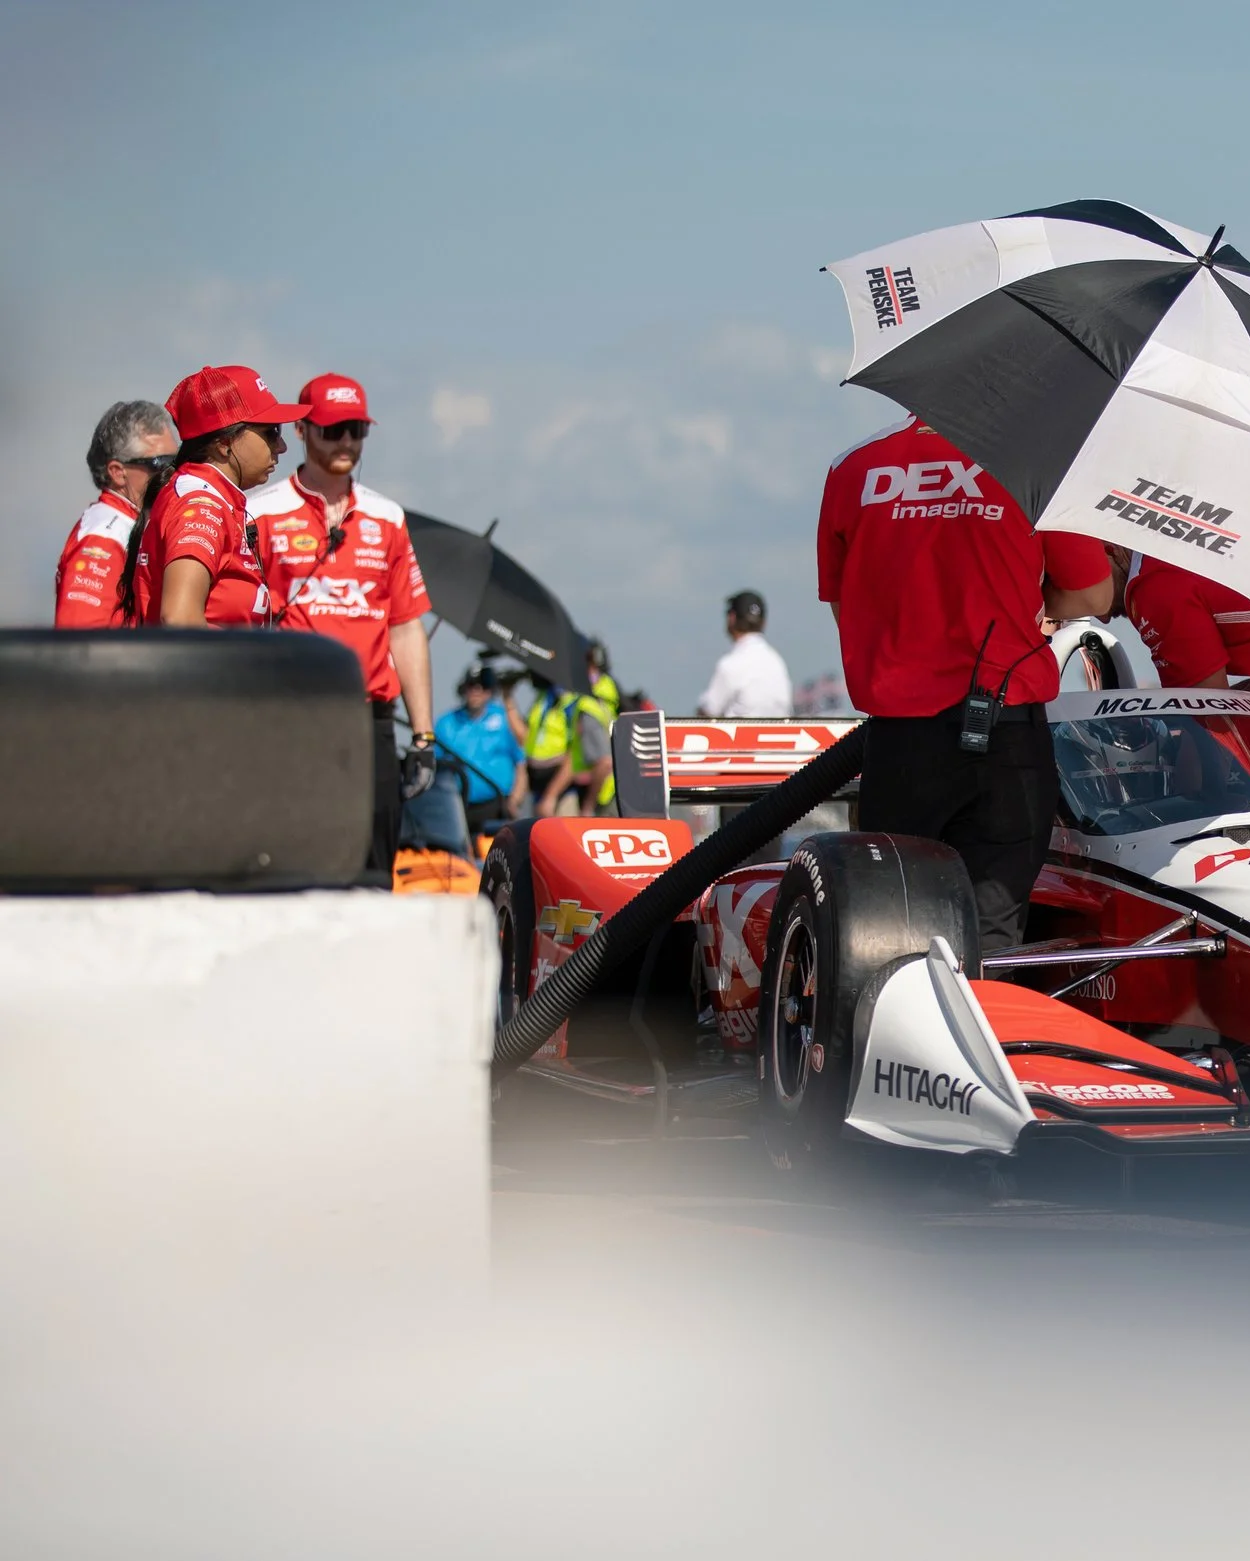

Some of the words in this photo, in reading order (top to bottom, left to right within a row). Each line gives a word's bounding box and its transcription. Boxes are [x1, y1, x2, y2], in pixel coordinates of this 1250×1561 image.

[866, 267, 897, 329] PENSKE
[893, 267, 920, 312] TEAM
[860, 461, 984, 507] DEX
[1130, 477, 1233, 526] TEAM
[891, 498, 1004, 521] imaging
[1095, 494, 1237, 555] PENSKE
[288, 576, 377, 608] DEX
[587, 834, 667, 863] PPG
[790, 850, 826, 906] Firestone
[874, 1059, 982, 1116] HITACHI
[1051, 1084, 1169, 1094] GOOD
[1058, 1092, 1176, 1101] RANCHERS
